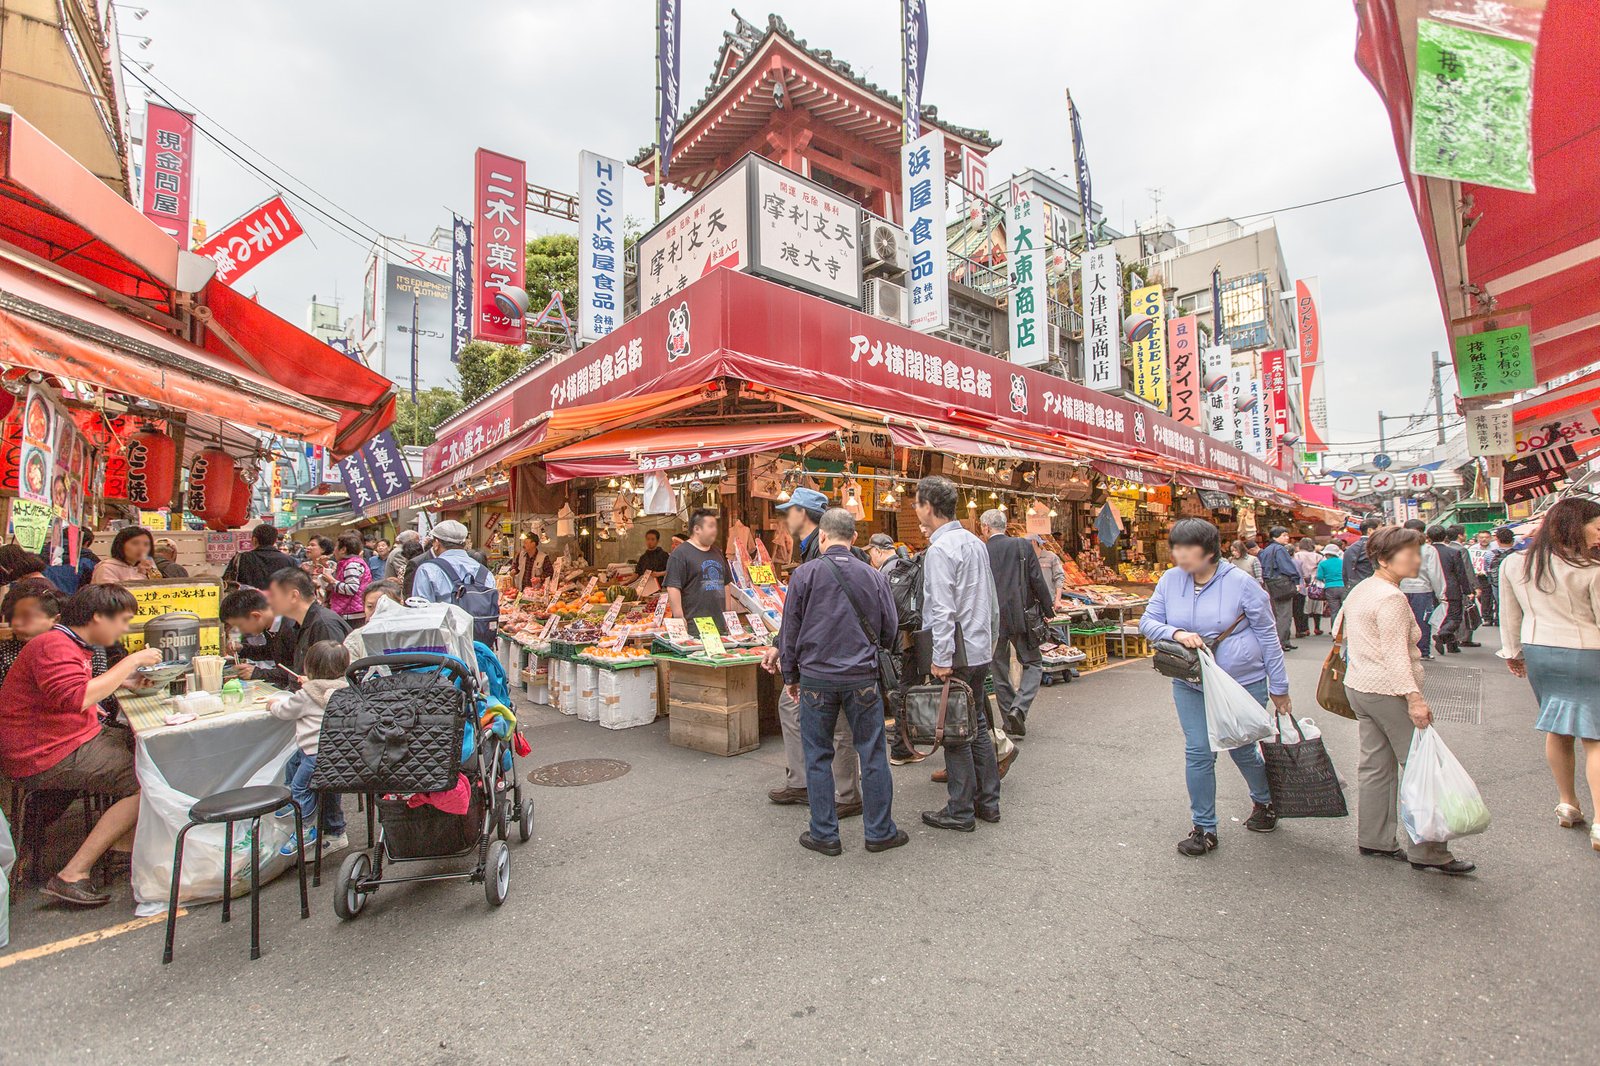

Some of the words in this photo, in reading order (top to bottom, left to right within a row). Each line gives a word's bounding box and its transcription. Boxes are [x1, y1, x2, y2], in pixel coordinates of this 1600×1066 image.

[154, 130, 181, 214] 現金問屋
[484, 171, 520, 292] 二木の菓子
[650, 207, 727, 277] 摩利支天
[763, 193, 854, 249] 摩利支天
[909, 145, 934, 281] 浜屋食品
[780, 241, 842, 280] 徳大寺
[1014, 224, 1036, 349] 大東商店
[1089, 272, 1109, 382] 大津屋商店
[1300, 297, 1313, 334] ロンドン
[550, 337, 643, 409] アメ横開運食品街
[850, 334, 992, 399] アメ横開運食品街
[1174, 323, 1195, 422] 豆のダイマス
[1043, 391, 1124, 433] アメ横開運食品街
[1211, 394, 1224, 431] 味堂
[127, 440, 149, 502] たこ焼
[441, 424, 485, 469] 二木の菓子
[189, 454, 209, 512] たこ焼
[1338, 473, 1429, 491] アメ横
[160, 634, 197, 649] SPORTIF
